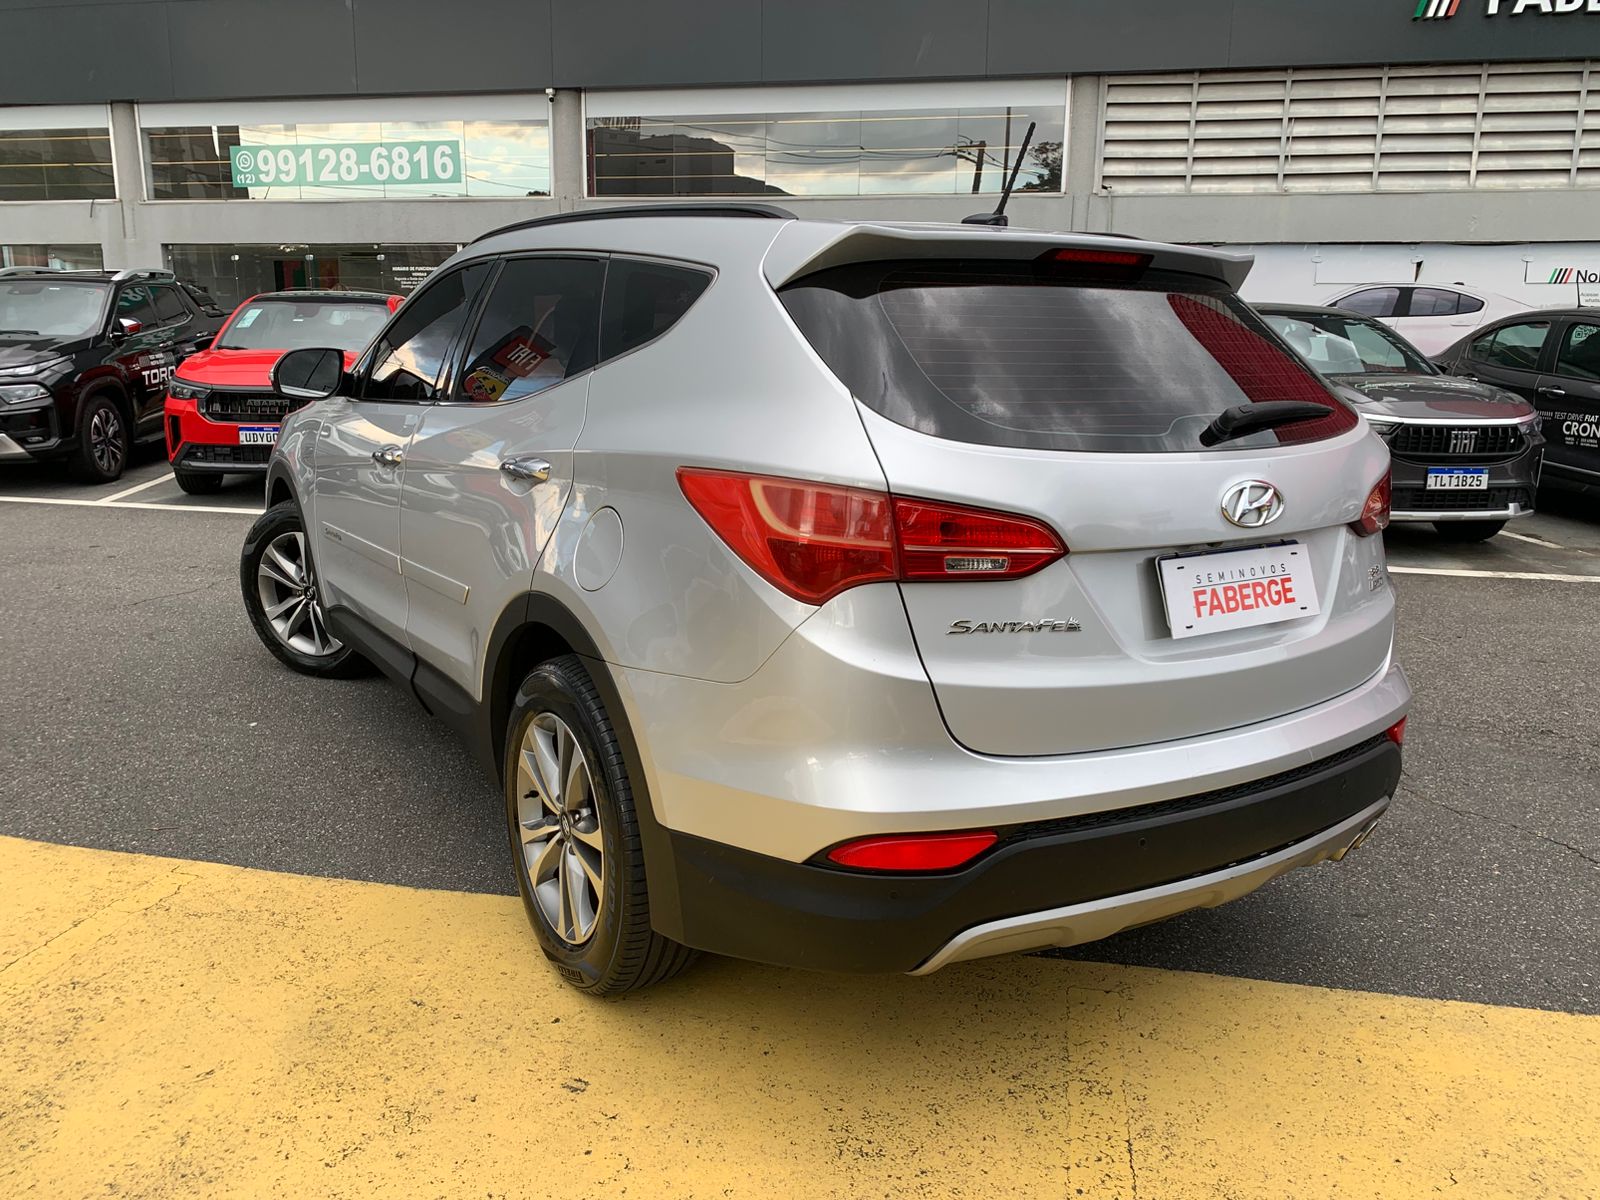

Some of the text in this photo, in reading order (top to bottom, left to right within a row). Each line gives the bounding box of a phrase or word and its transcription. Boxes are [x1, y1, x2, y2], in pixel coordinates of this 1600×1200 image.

[258, 145, 453, 183] 99128-6816
[236, 173, 255, 184] (12)
[1576, 269, 1600, 283] No
[141, 365, 176, 385] TORO
[1554, 411, 1599, 423] TEST DRIVE FIAT
[1562, 421, 1600, 438] CRON
[1449, 431, 1478, 454] FIAT
[1433, 475, 1482, 487] TLT1B25
[1195, 563, 1287, 584] SEMINOVOS
[1193, 576, 1296, 618] FABERGE
